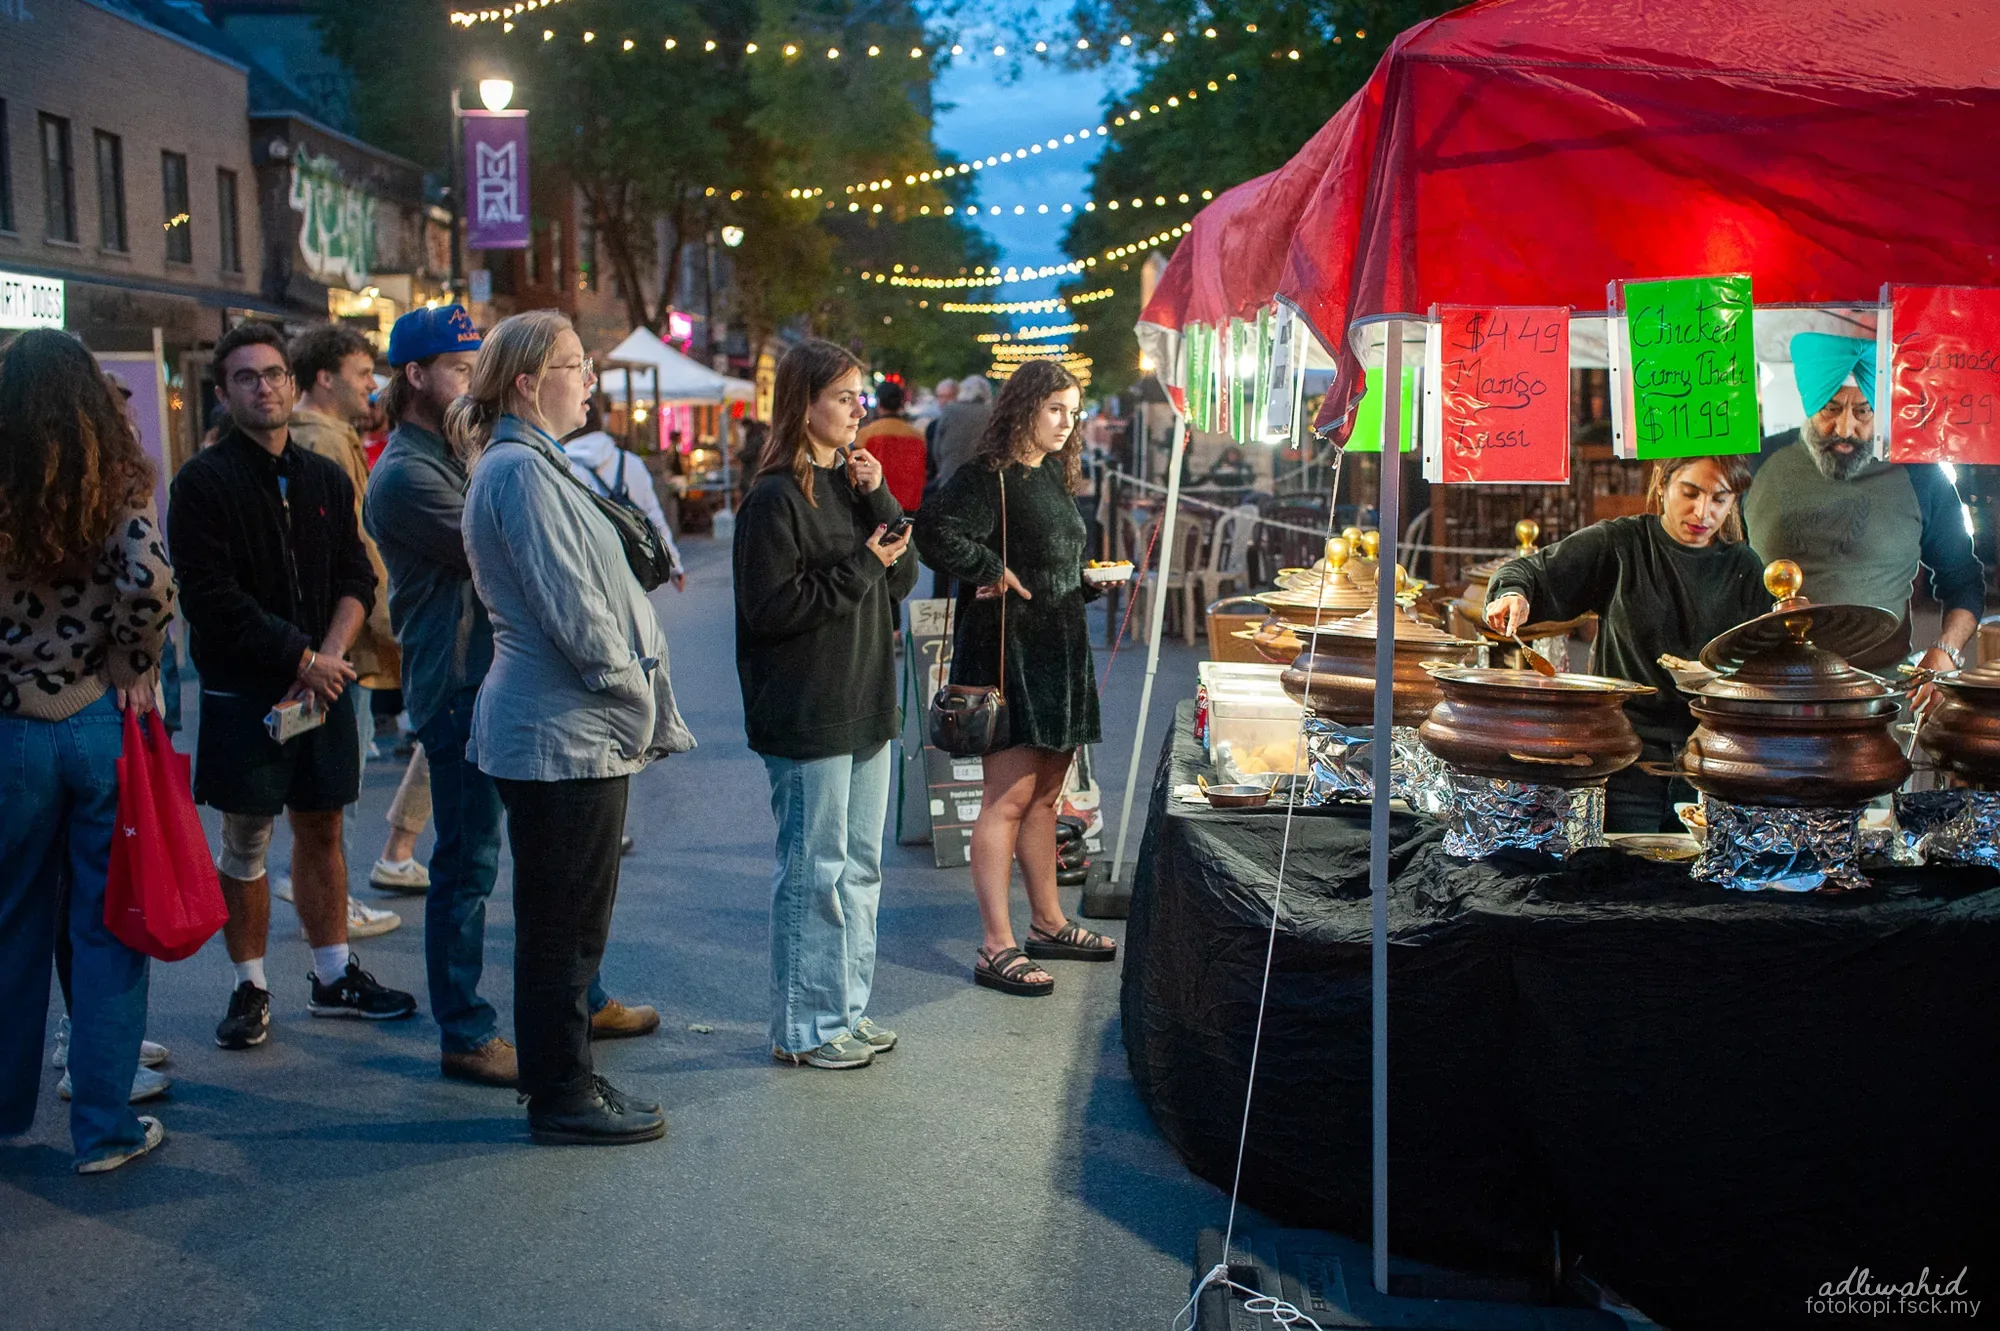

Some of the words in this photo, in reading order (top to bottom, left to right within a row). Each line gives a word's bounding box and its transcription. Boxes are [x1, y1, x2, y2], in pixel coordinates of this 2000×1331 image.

[32, 284, 62, 319] DOGS
[1632, 298, 1747, 348] Chicken
[1449, 357, 1548, 416] Mango
[1633, 358, 1692, 406] Curry
[1456, 417, 1531, 451] Lassi
[1636, 399, 1730, 445] $11.99
